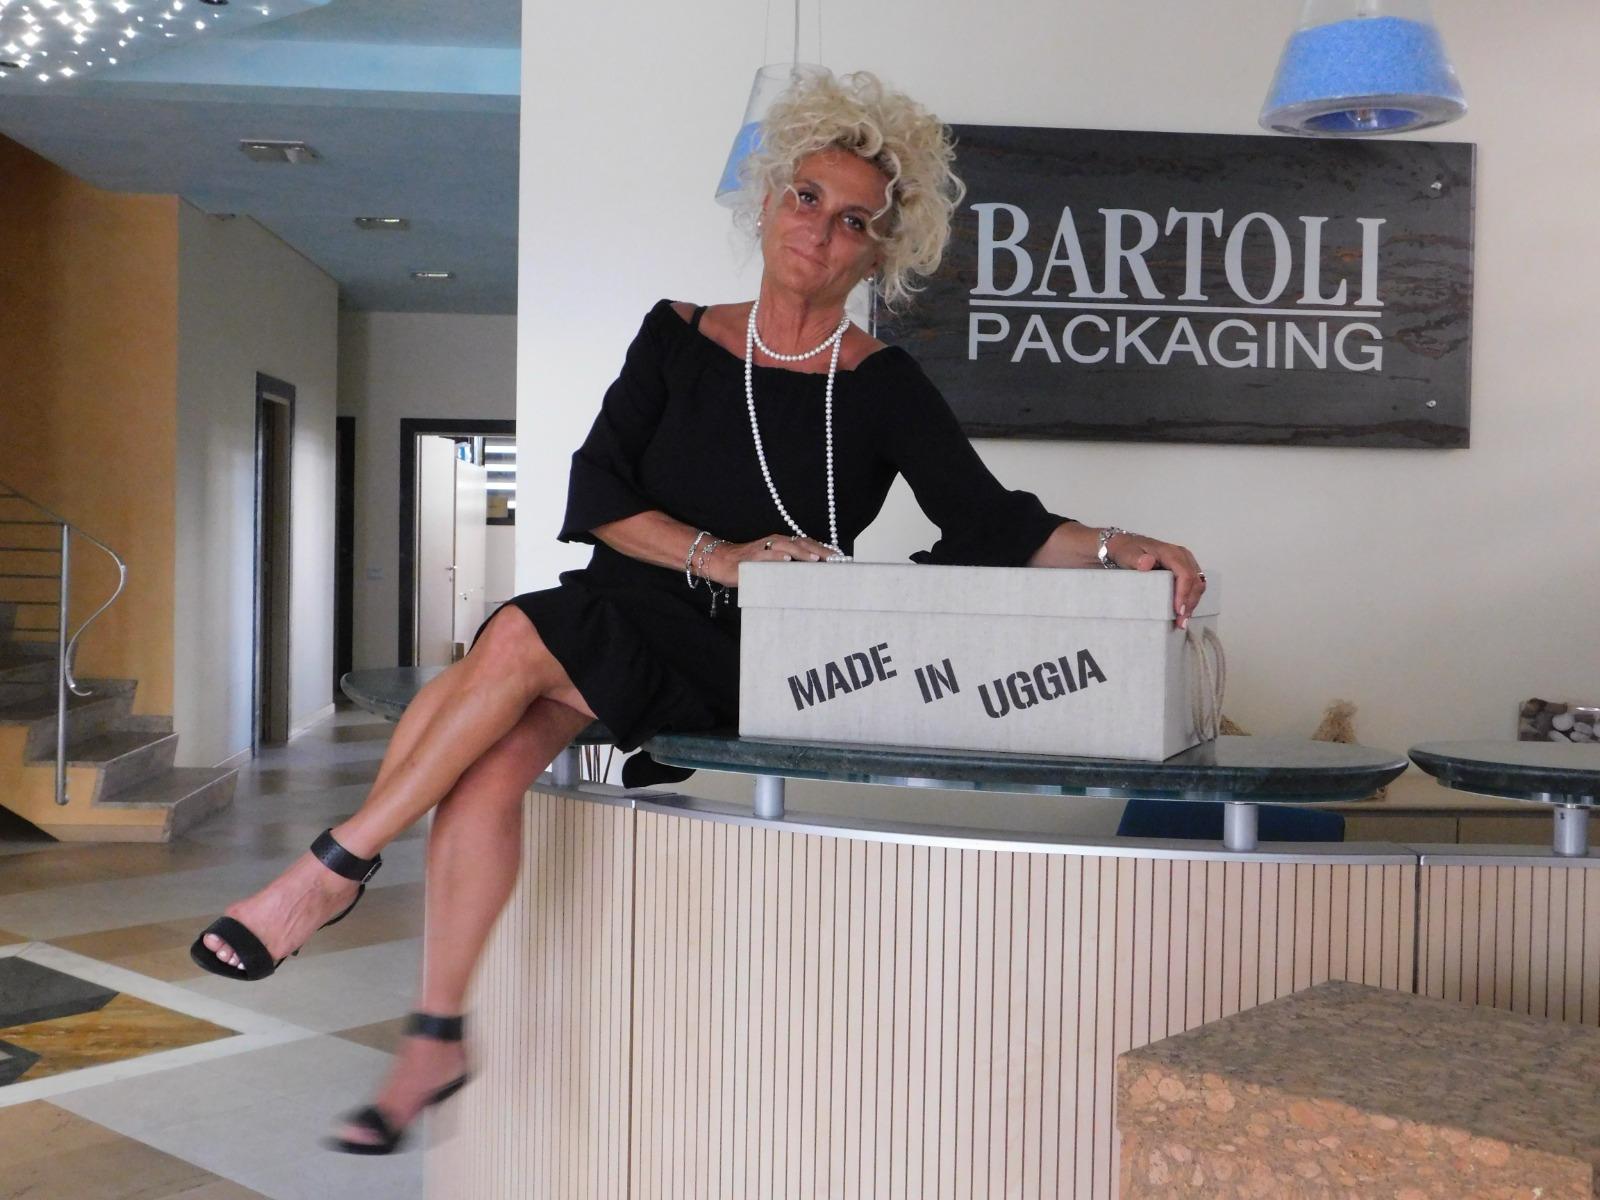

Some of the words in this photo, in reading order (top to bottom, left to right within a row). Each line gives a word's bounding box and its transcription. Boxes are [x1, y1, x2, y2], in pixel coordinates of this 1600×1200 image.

[969, 202, 1386, 306] BARTOLI
[968, 312, 1383, 371] PACKAGING
[787, 643, 897, 711] MADE
[914, 658, 961, 704] IN
[977, 648, 1107, 719] UGGIA
